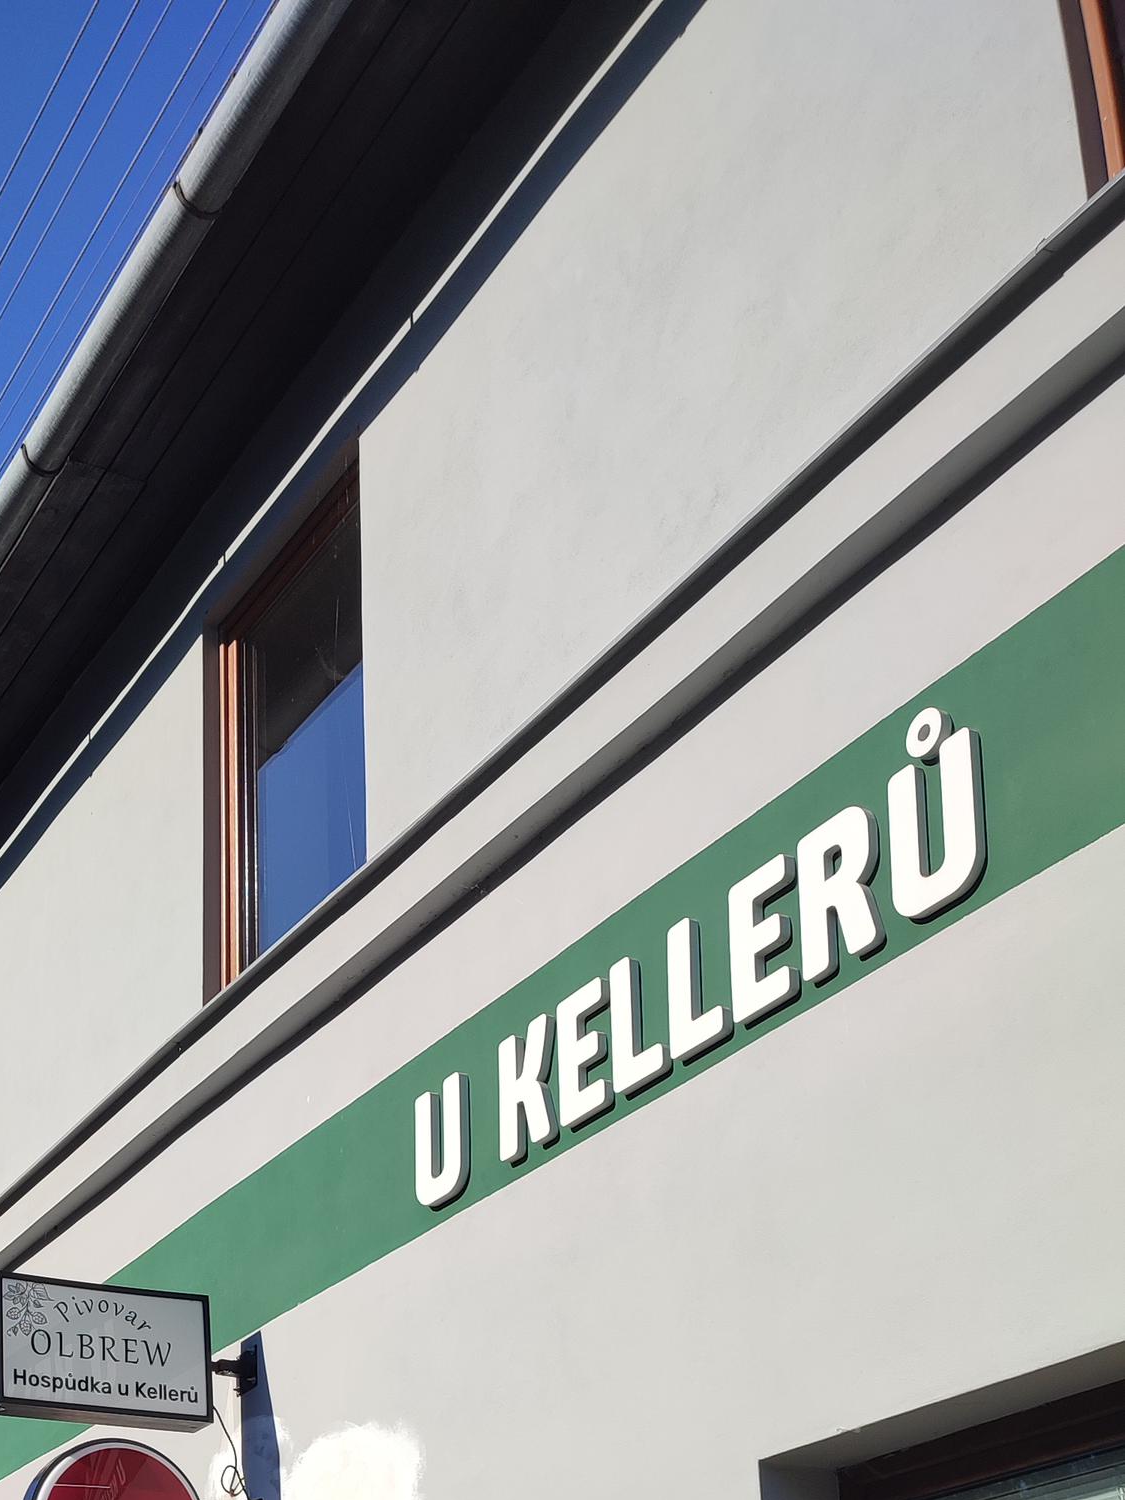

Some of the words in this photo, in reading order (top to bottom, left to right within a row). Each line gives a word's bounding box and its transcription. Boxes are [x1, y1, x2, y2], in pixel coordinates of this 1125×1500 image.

[414, 1071, 468, 1208] U
[498, 706, 984, 1164] KELLERŮ
[54, 1296, 152, 1331] Pivovar
[31, 1330, 172, 1367] OLBREW
[13, 1368, 112, 1394] Hospůdka
[118, 1383, 129, 1396] u
[135, 1381, 198, 1403] Kellerů
